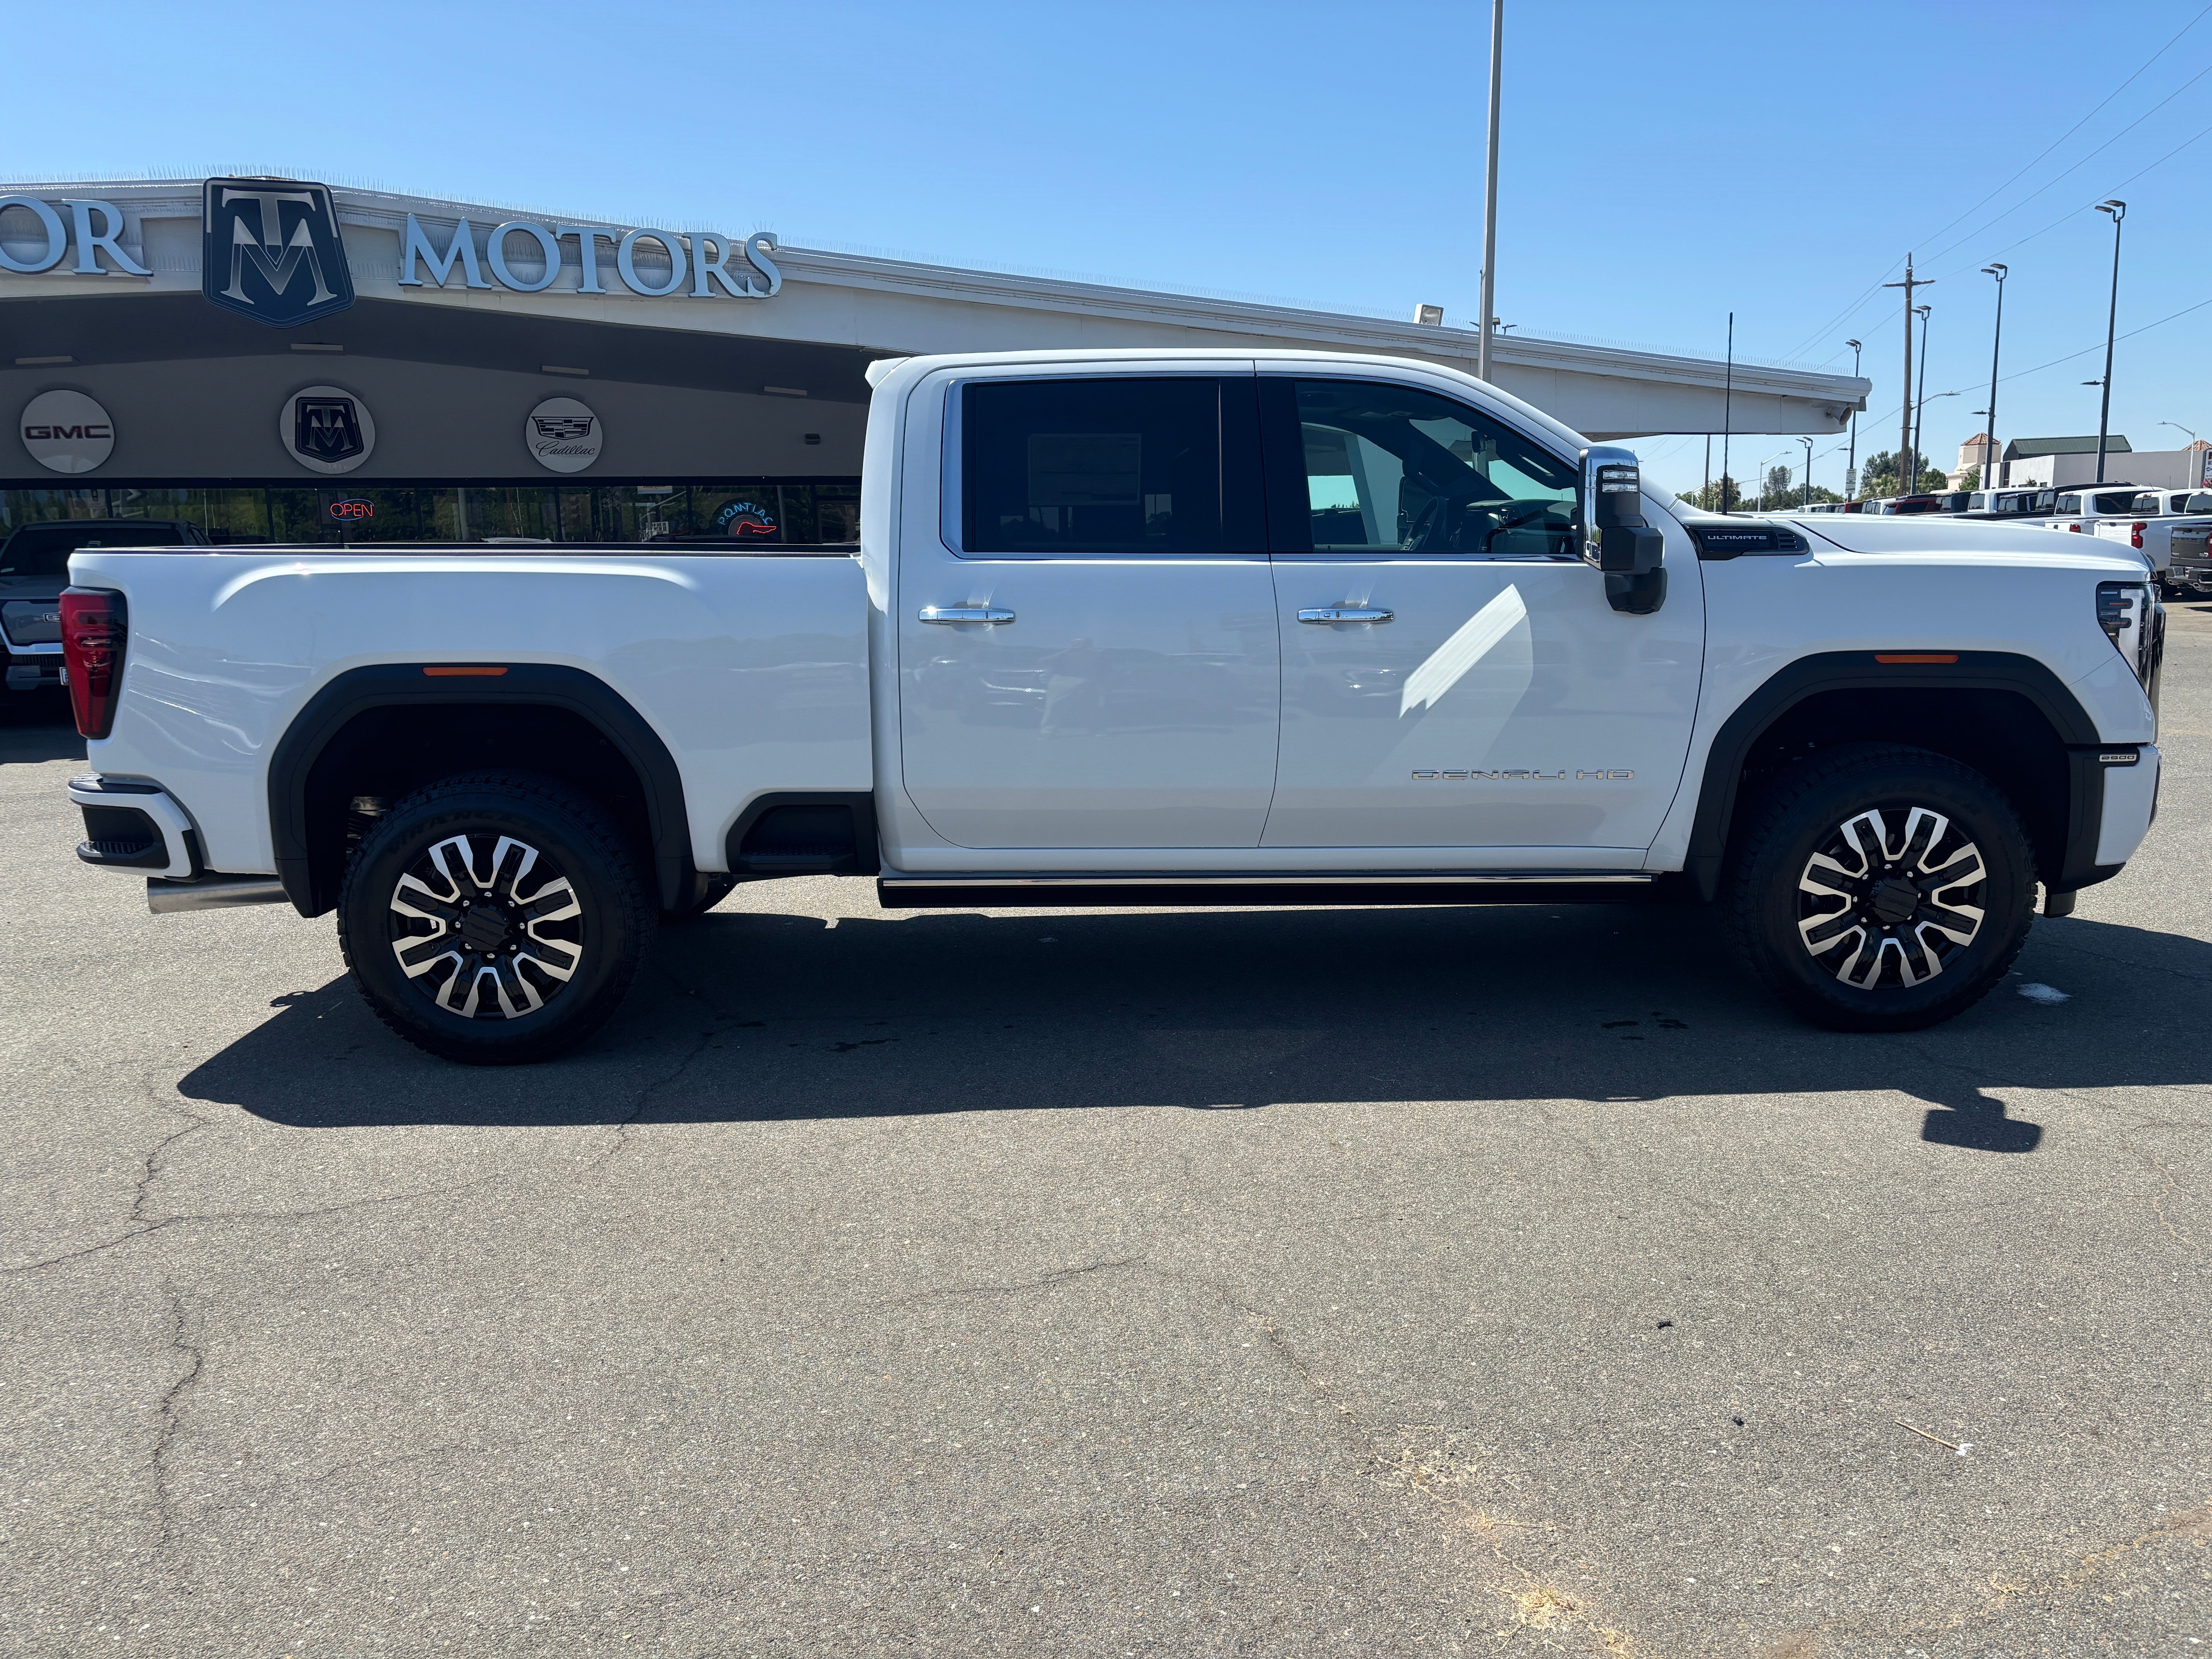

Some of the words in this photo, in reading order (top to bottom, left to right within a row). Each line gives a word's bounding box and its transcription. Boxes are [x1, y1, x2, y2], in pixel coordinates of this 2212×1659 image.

[398, 213, 782, 299] MOTORS
[25, 425, 111, 439] GMC
[536, 441, 595, 457] Cadillac
[330, 503, 373, 517] OPEN
[718, 502, 773, 526] PONTIAC
[1412, 769, 1565, 780] DENALI
[1577, 769, 1635, 780] HD
